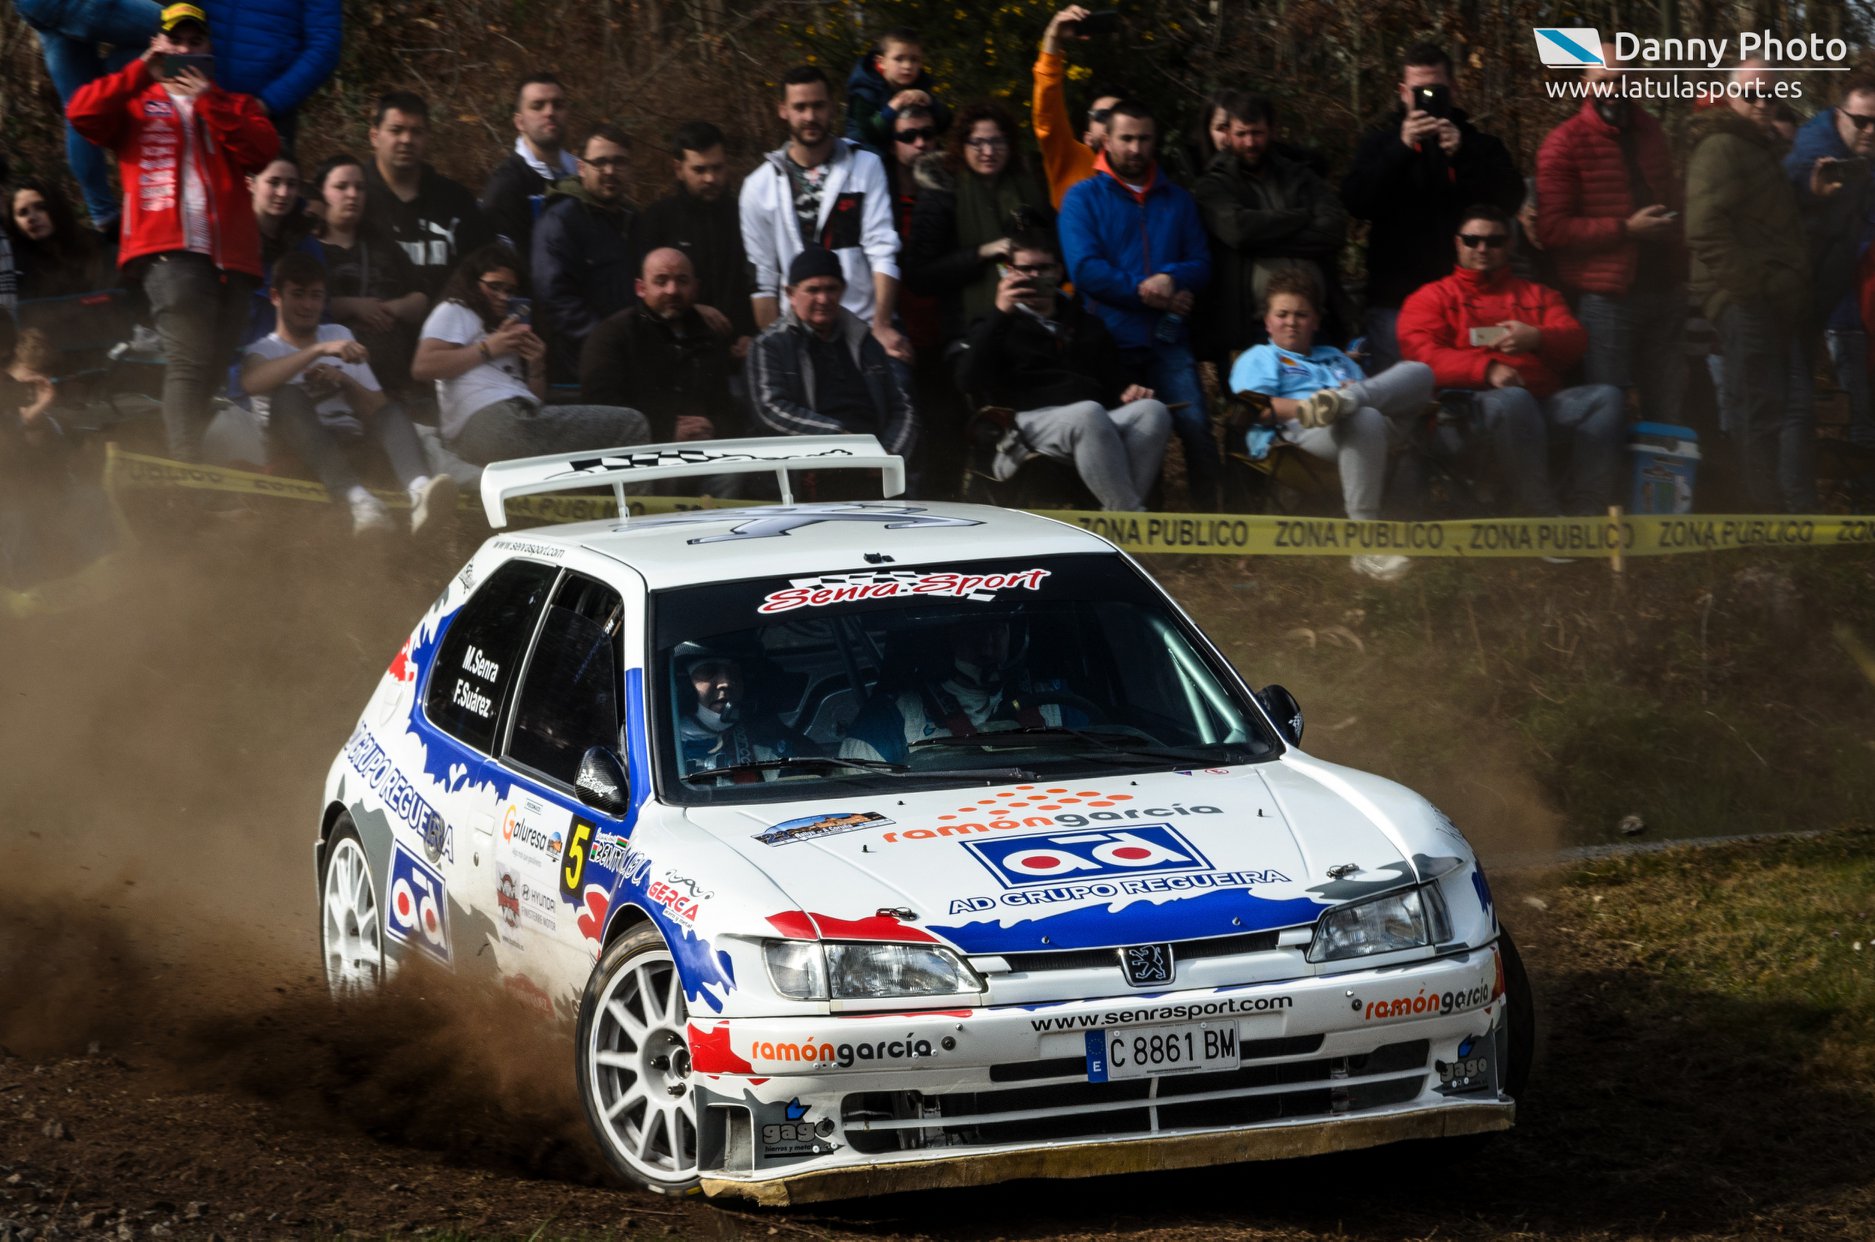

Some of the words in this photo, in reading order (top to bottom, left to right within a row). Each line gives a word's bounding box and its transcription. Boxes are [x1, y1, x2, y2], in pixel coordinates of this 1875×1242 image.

[1147, 519, 1249, 547] PUBLICO
[1275, 520, 1338, 548] ZONA
[1344, 522, 1443, 550] PUBLICO
[1470, 523, 1532, 550] ZONA
[1658, 521, 1714, 548] ZONA
[1720, 519, 1815, 546] PUBLICO
[758, 582, 901, 612] Senra
[911, 569, 1050, 596] Sport
[462, 644, 499, 683] M.Senra
[453, 678, 492, 718] F.Suárez
[503, 804, 547, 851] Galuresa
[882, 803, 1224, 843] ramóngarcía
[565, 823, 591, 889] 5
[647, 881, 699, 922] GERCA
[949, 894, 996, 915] AD
[1001, 880, 1118, 906] GRUPO
[1121, 868, 1292, 895] REGUEIRA
[1031, 996, 1294, 1031] www.senrasport.com
[1365, 977, 1489, 1020] ramóngarcía
[752, 1032, 933, 1068] ramóngarcía
[1093, 1060, 1102, 1072] E
[1110, 1038, 1126, 1068] C
[1133, 1032, 1194, 1066] 8861
[1204, 1028, 1236, 1060] BM
[762, 1121, 836, 1145] gago
[765, 1144, 788, 1153] hierros
